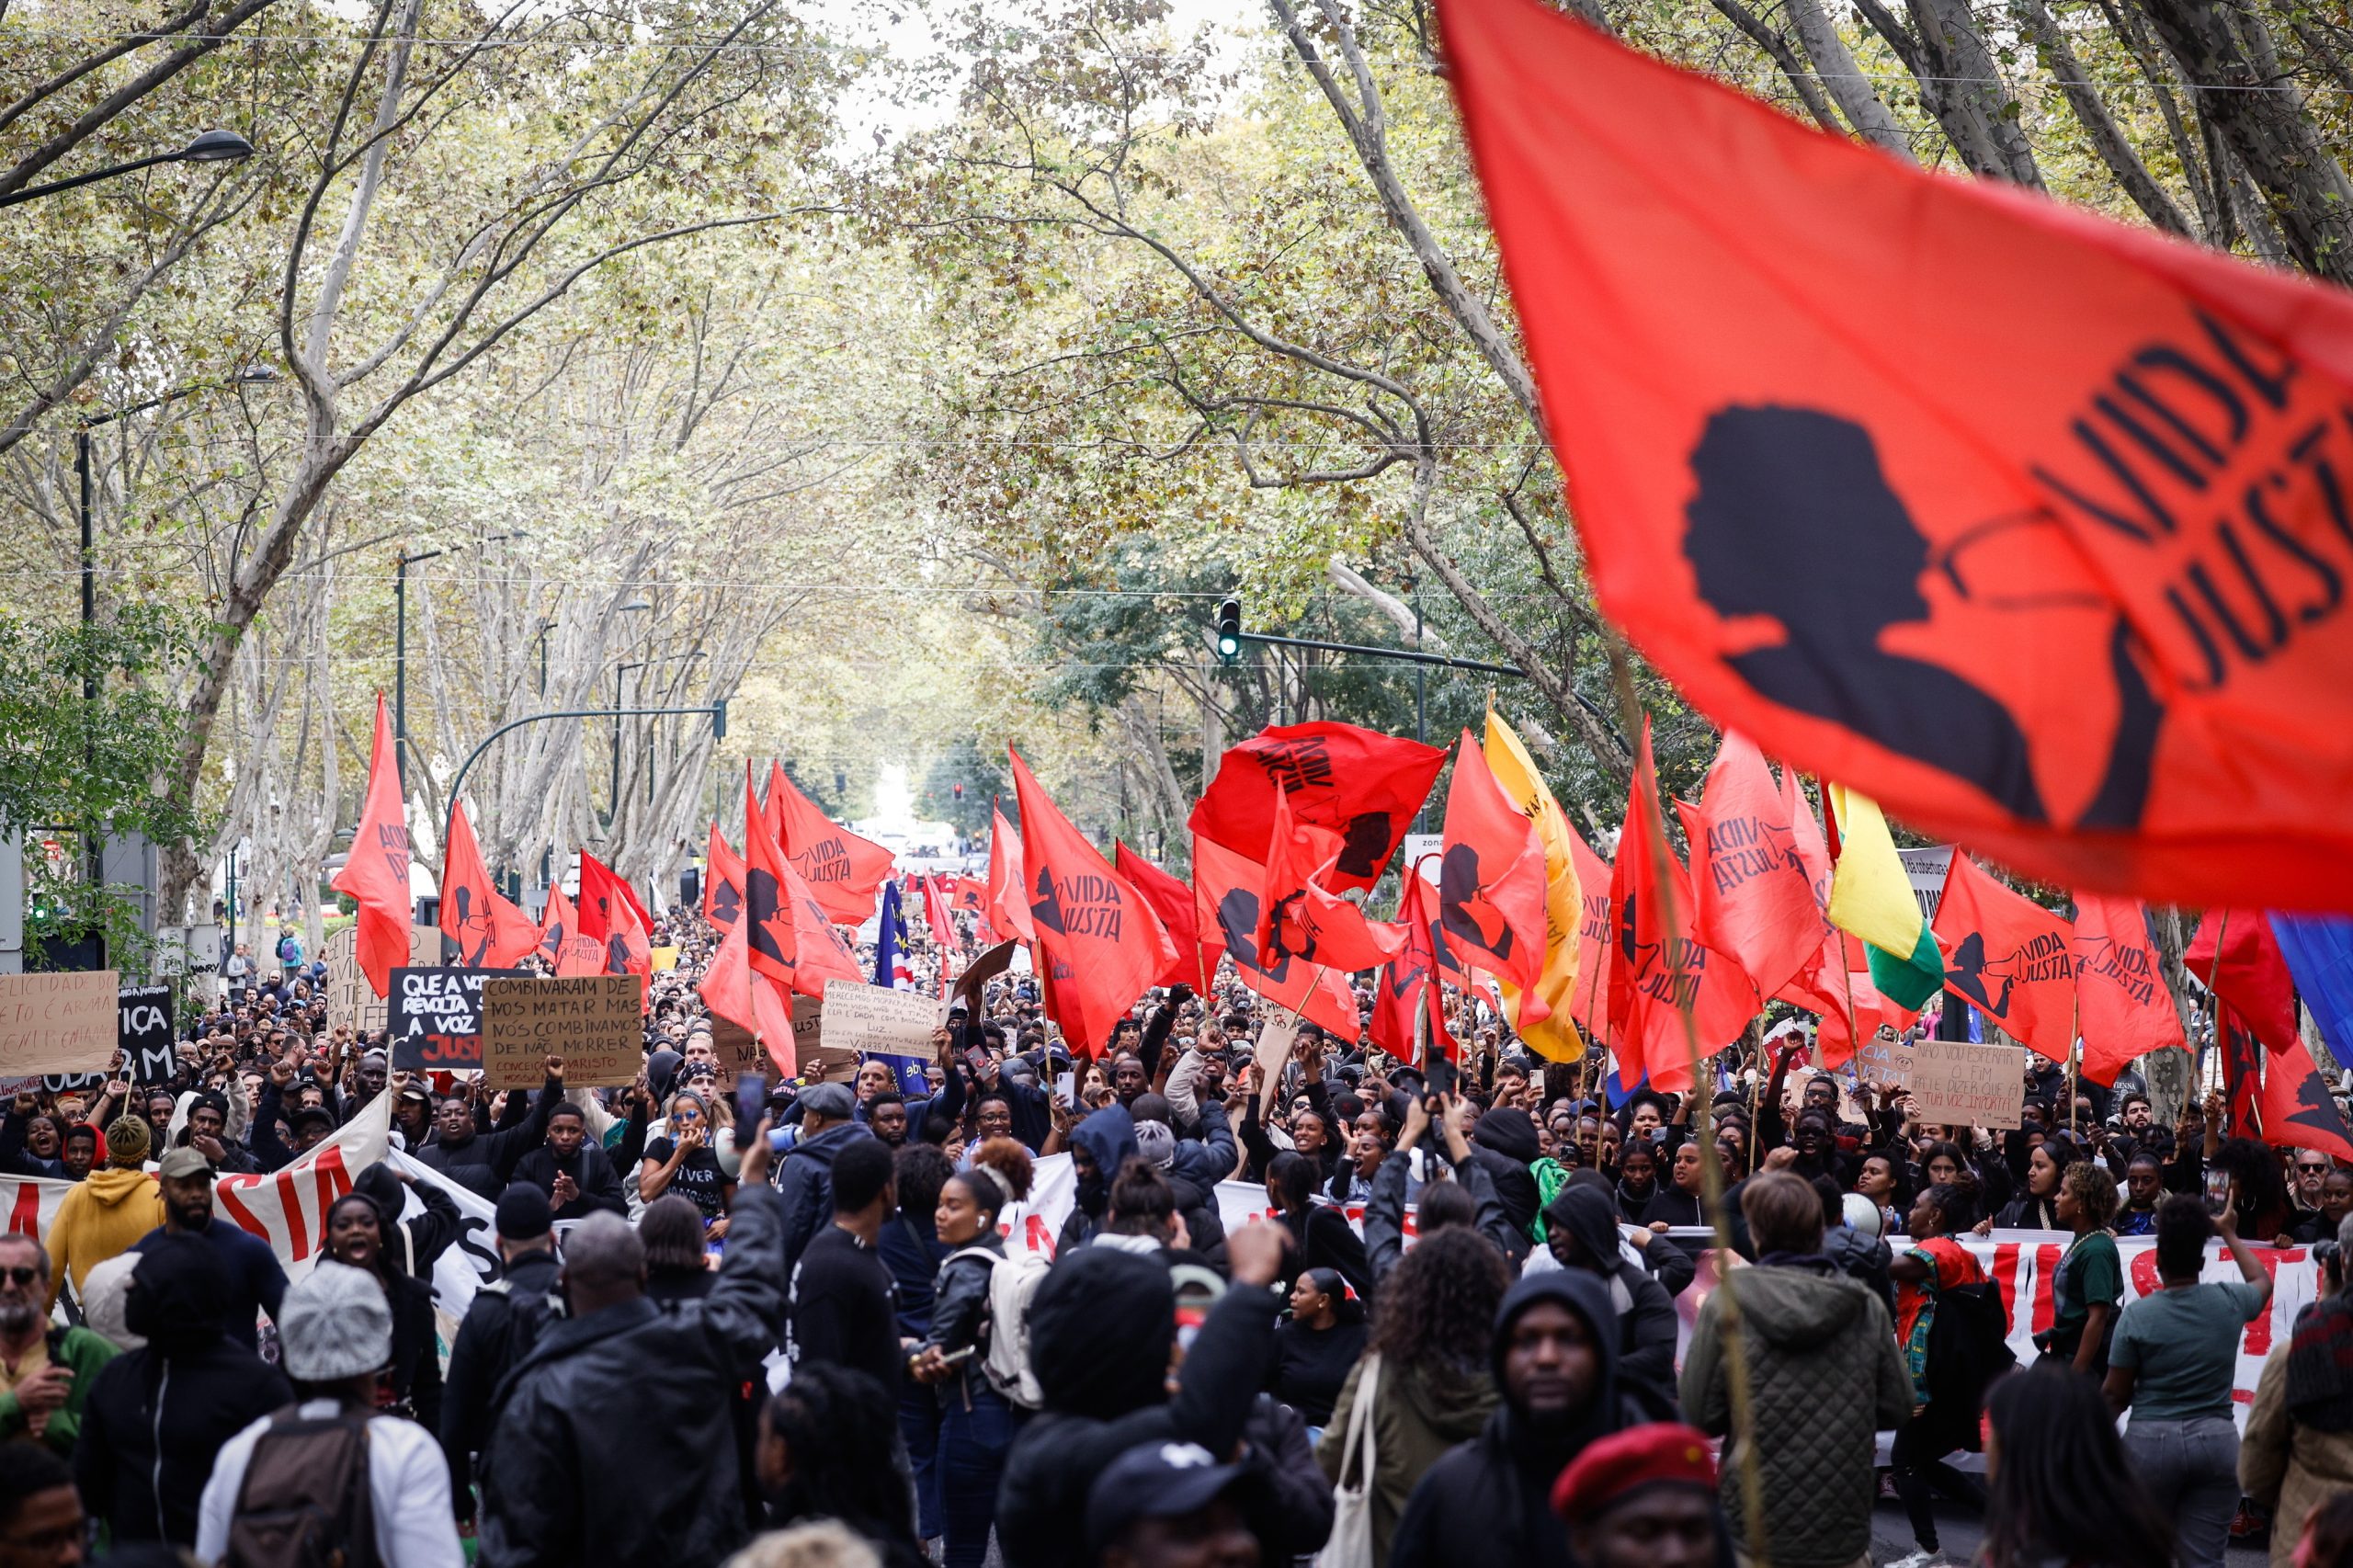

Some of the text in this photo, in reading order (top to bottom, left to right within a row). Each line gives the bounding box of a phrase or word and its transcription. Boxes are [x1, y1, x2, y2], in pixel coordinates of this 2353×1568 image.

[2164, 401, 2353, 689] JUST
[808, 836, 847, 864] VIDA
[809, 858, 851, 882] JUSTA
[1064, 875, 1121, 904] VIDA
[2021, 931, 2066, 961] VIDA
[2022, 953, 2073, 983] JUSTA
[2113, 937, 2154, 981] VIDA
[403, 974, 442, 997] QUE
[444, 975, 461, 994] A
[488, 977, 631, 996] COMBINARAM DE
[827, 980, 835, 989] A
[838, 982, 859, 993] VIDA
[2094, 959, 2154, 1006] JUSTA
[63, 994, 110, 1017] ARMA
[403, 994, 470, 1015] REVOLTA
[492, 1001, 526, 1017] NOS
[533, 999, 596, 1017] MATAR
[607, 998, 642, 1014] MAS
[408, 1015, 476, 1036] A VOZ
[854, 1011, 875, 1021] DADA
[493, 1018, 642, 1038] NÓS COMBINAMOS
[495, 1036, 631, 1055] DE NÃO MORRER
[1945, 1046, 1964, 1061] VOU
[1967, 1048, 2013, 1066] ESPERAR
[1951, 1064, 1992, 1082] O FIM
[1948, 1079, 1977, 1095] DIZER
[1982, 1083, 2003, 1096] QUE
[2008, 1084, 2018, 1097] A
[1923, 1092, 1943, 1106] TUA
[1947, 1094, 1963, 1108] VOZ
